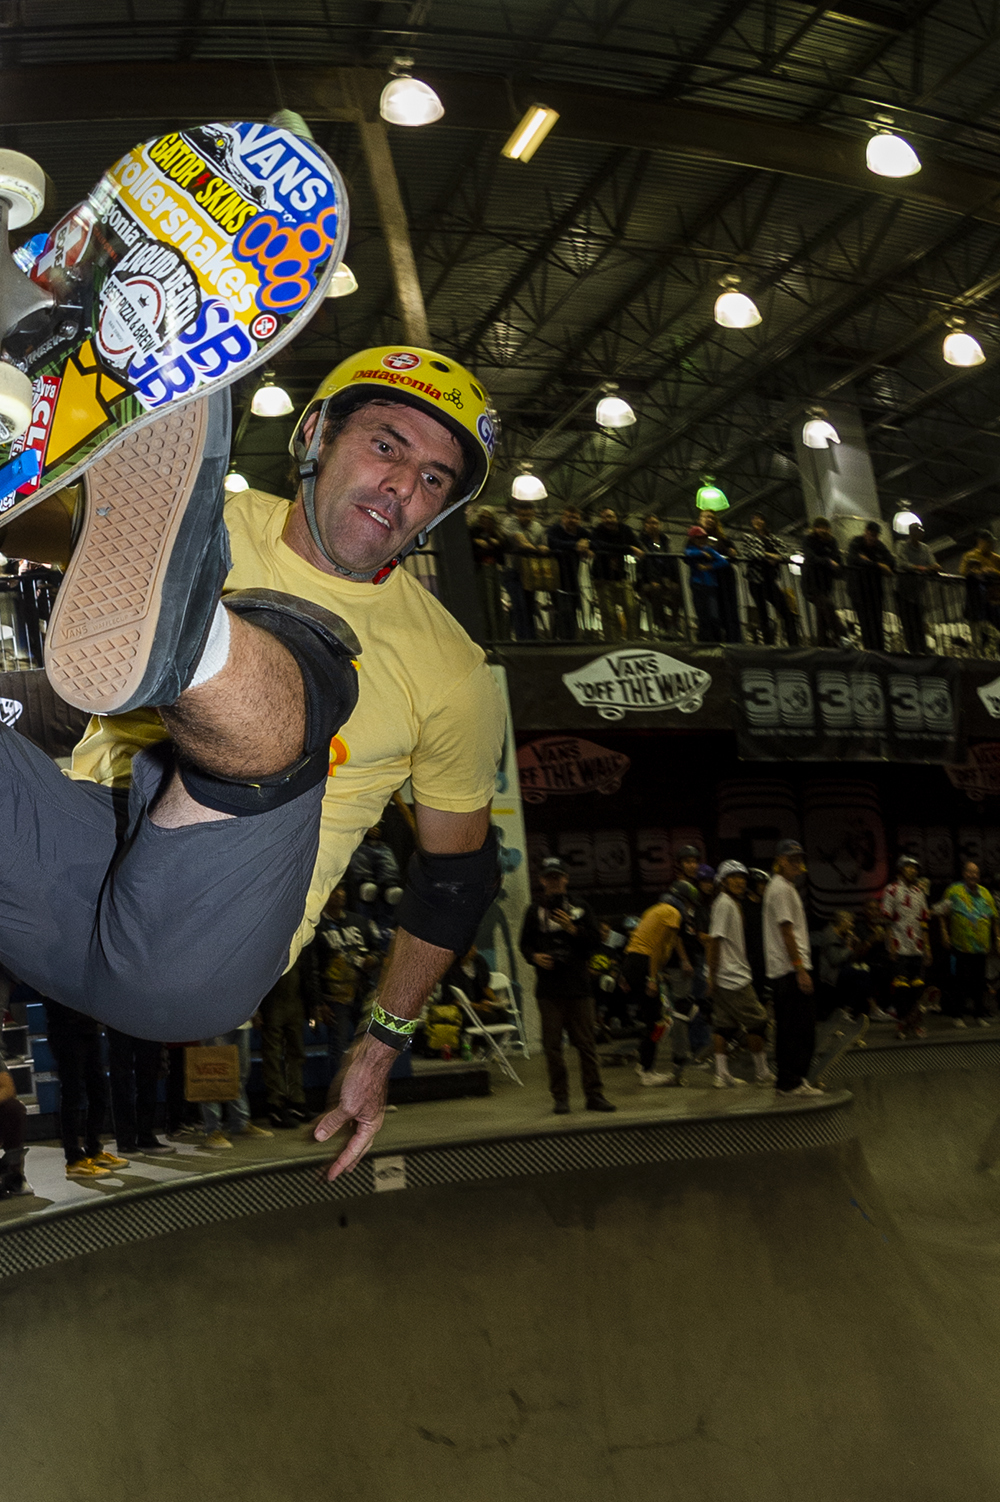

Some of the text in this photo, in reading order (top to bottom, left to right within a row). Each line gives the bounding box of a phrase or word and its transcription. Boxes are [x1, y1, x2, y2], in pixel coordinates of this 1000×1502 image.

[150, 133, 257, 234] GATOR SKINS
[239, 123, 334, 211] VANS
[101, 203, 140, 247] gonia
[113, 152, 259, 313] rollersnakes
[111, 241, 180, 280] LIQUID
[103, 281, 124, 308] BEST
[118, 297, 136, 327] PIZZA
[133, 324, 157, 354] BREW
[178, 299, 251, 378] SB
[352, 368, 443, 401] patagonia
[61, 621, 89, 640] VANS
[605, 653, 660, 678] VANS
[616, 676, 658, 703] THE
[530, 740, 580, 762] VANS
